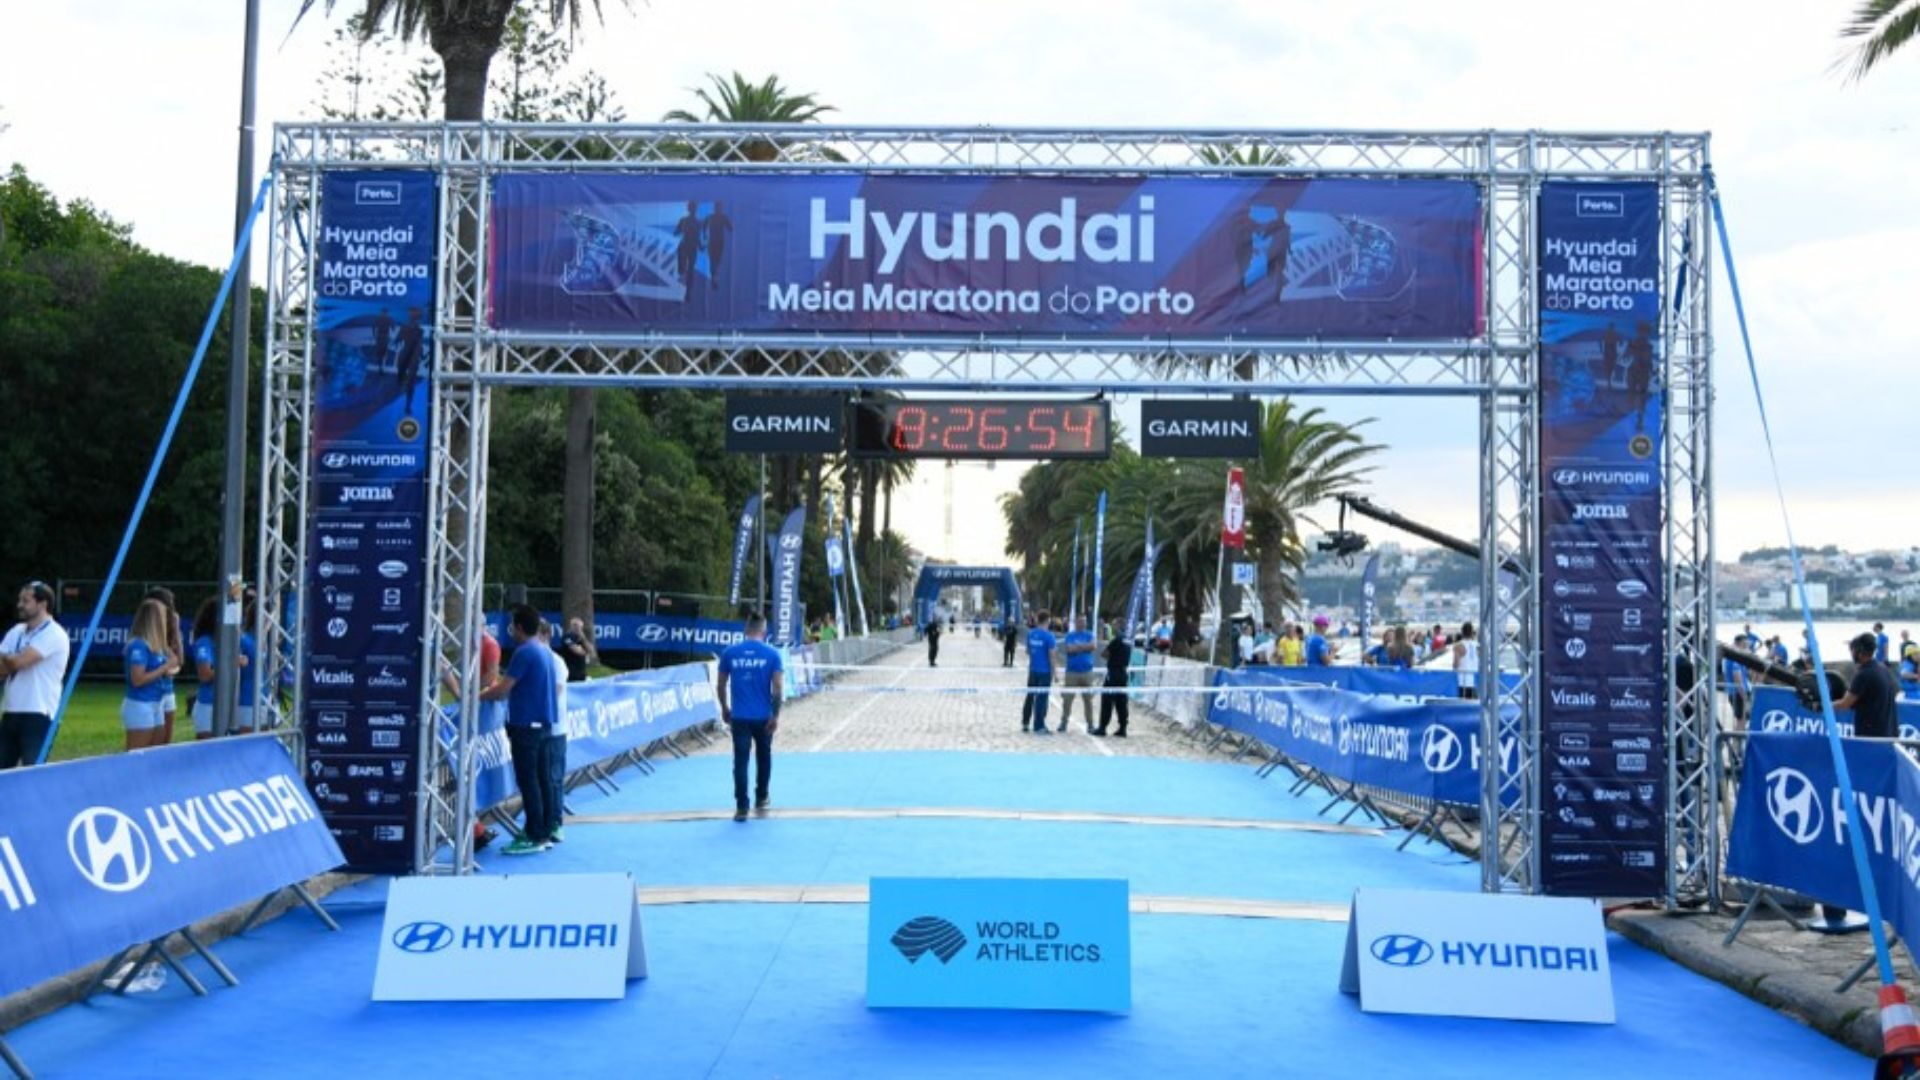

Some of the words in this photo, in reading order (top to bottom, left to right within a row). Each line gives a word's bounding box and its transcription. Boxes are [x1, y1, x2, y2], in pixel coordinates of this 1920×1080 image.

[325, 226, 414, 246] Hyundai
[810, 195, 1155, 275] Hyundai
[347, 243, 397, 260] Meia
[1546, 238, 1637, 258] Hyundai
[323, 262, 428, 279] Maratona
[1568, 256, 1622, 275] Meia
[323, 280, 347, 297] do
[349, 279, 407, 297] Porto
[1546, 274, 1654, 292] Maratona
[768, 282, 856, 313] Meia
[863, 282, 1040, 314] Maratona
[1048, 284, 1091, 314] do
[1096, 285, 1195, 315] Porto
[1546, 291, 1571, 310] do
[1573, 292, 1634, 311] Porto
[351, 454, 415, 467] HYUNDAI
[1582, 471, 1649, 484] HYUNDAI
[778, 552, 796, 645] HYUNDAI
[671, 627, 745, 646] HYUNDA
[731, 658, 768, 668] STAFF
[145, 774, 315, 864] HYUNDAI
[462, 923, 617, 949] HYUNDAI
[976, 921, 1060, 940] WORLD
[976, 943, 1101, 963] ATHLETICS
[1442, 940, 1599, 972] HYUNDAI
